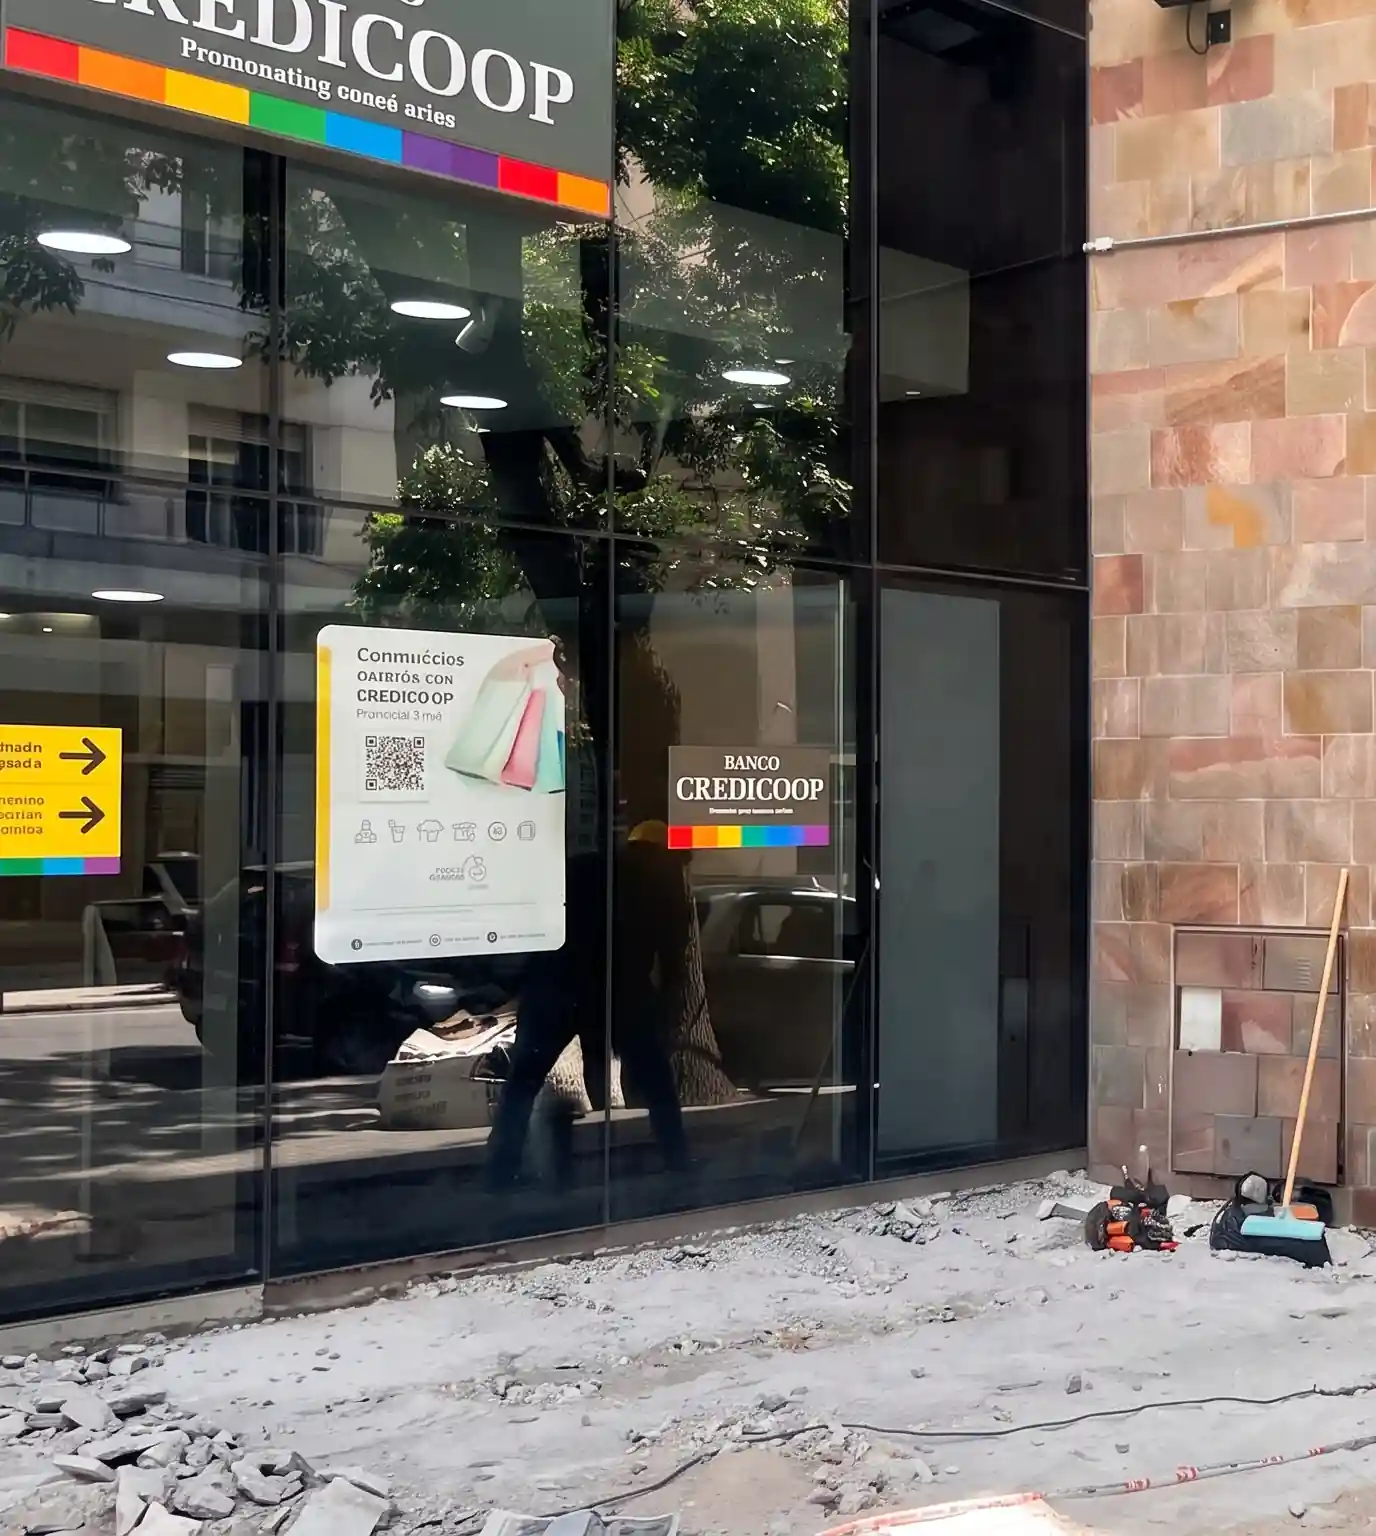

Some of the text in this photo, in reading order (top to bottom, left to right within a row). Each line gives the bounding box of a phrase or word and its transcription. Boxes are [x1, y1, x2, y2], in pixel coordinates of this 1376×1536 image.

[91, 0, 574, 125] EDICOOP
[180, 36, 332, 101] Promonating
[404, 102, 457, 129] aries
[425, 673, 454, 685] CON
[723, 755, 780, 771] BANCO
[676, 776, 825, 801] CREDICOOP
